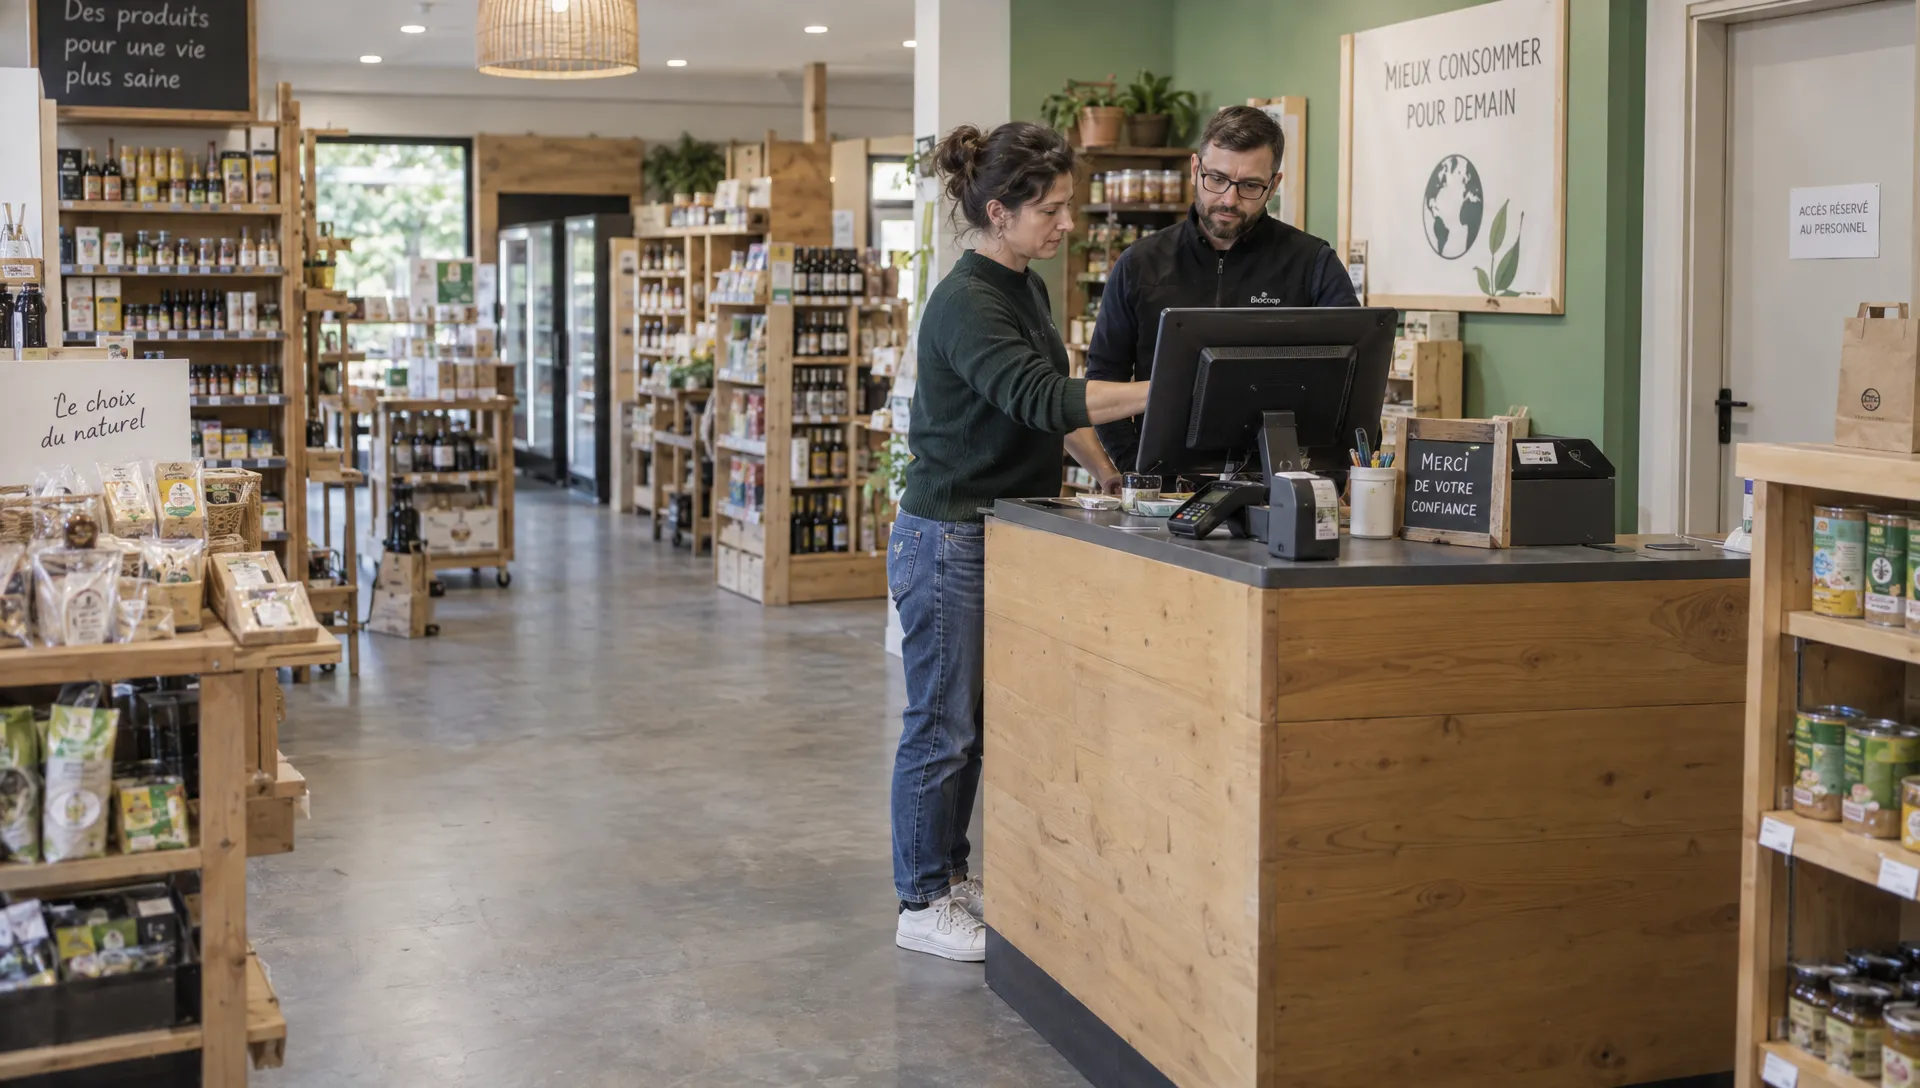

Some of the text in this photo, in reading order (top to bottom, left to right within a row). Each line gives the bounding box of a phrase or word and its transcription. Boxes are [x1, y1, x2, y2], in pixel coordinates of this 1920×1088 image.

[64, 0, 209, 32] Des produits
[65, 37, 206, 61] pour une vie
[1384, 37, 1542, 91] MIEUX CONSOMMER
[66, 61, 180, 93] plus saine
[1407, 88, 1516, 129] POUR DEMAIN
[1799, 200, 1869, 216] ACCÈS RÉSERVÉ
[1800, 221, 1867, 235] AU PERSONNEL
[86, 389, 136, 412] choix
[41, 407, 146, 449] du naturel
[1414, 479, 1474, 495] DE VOTRE
[1411, 500, 1477, 517] CONFIANCE
